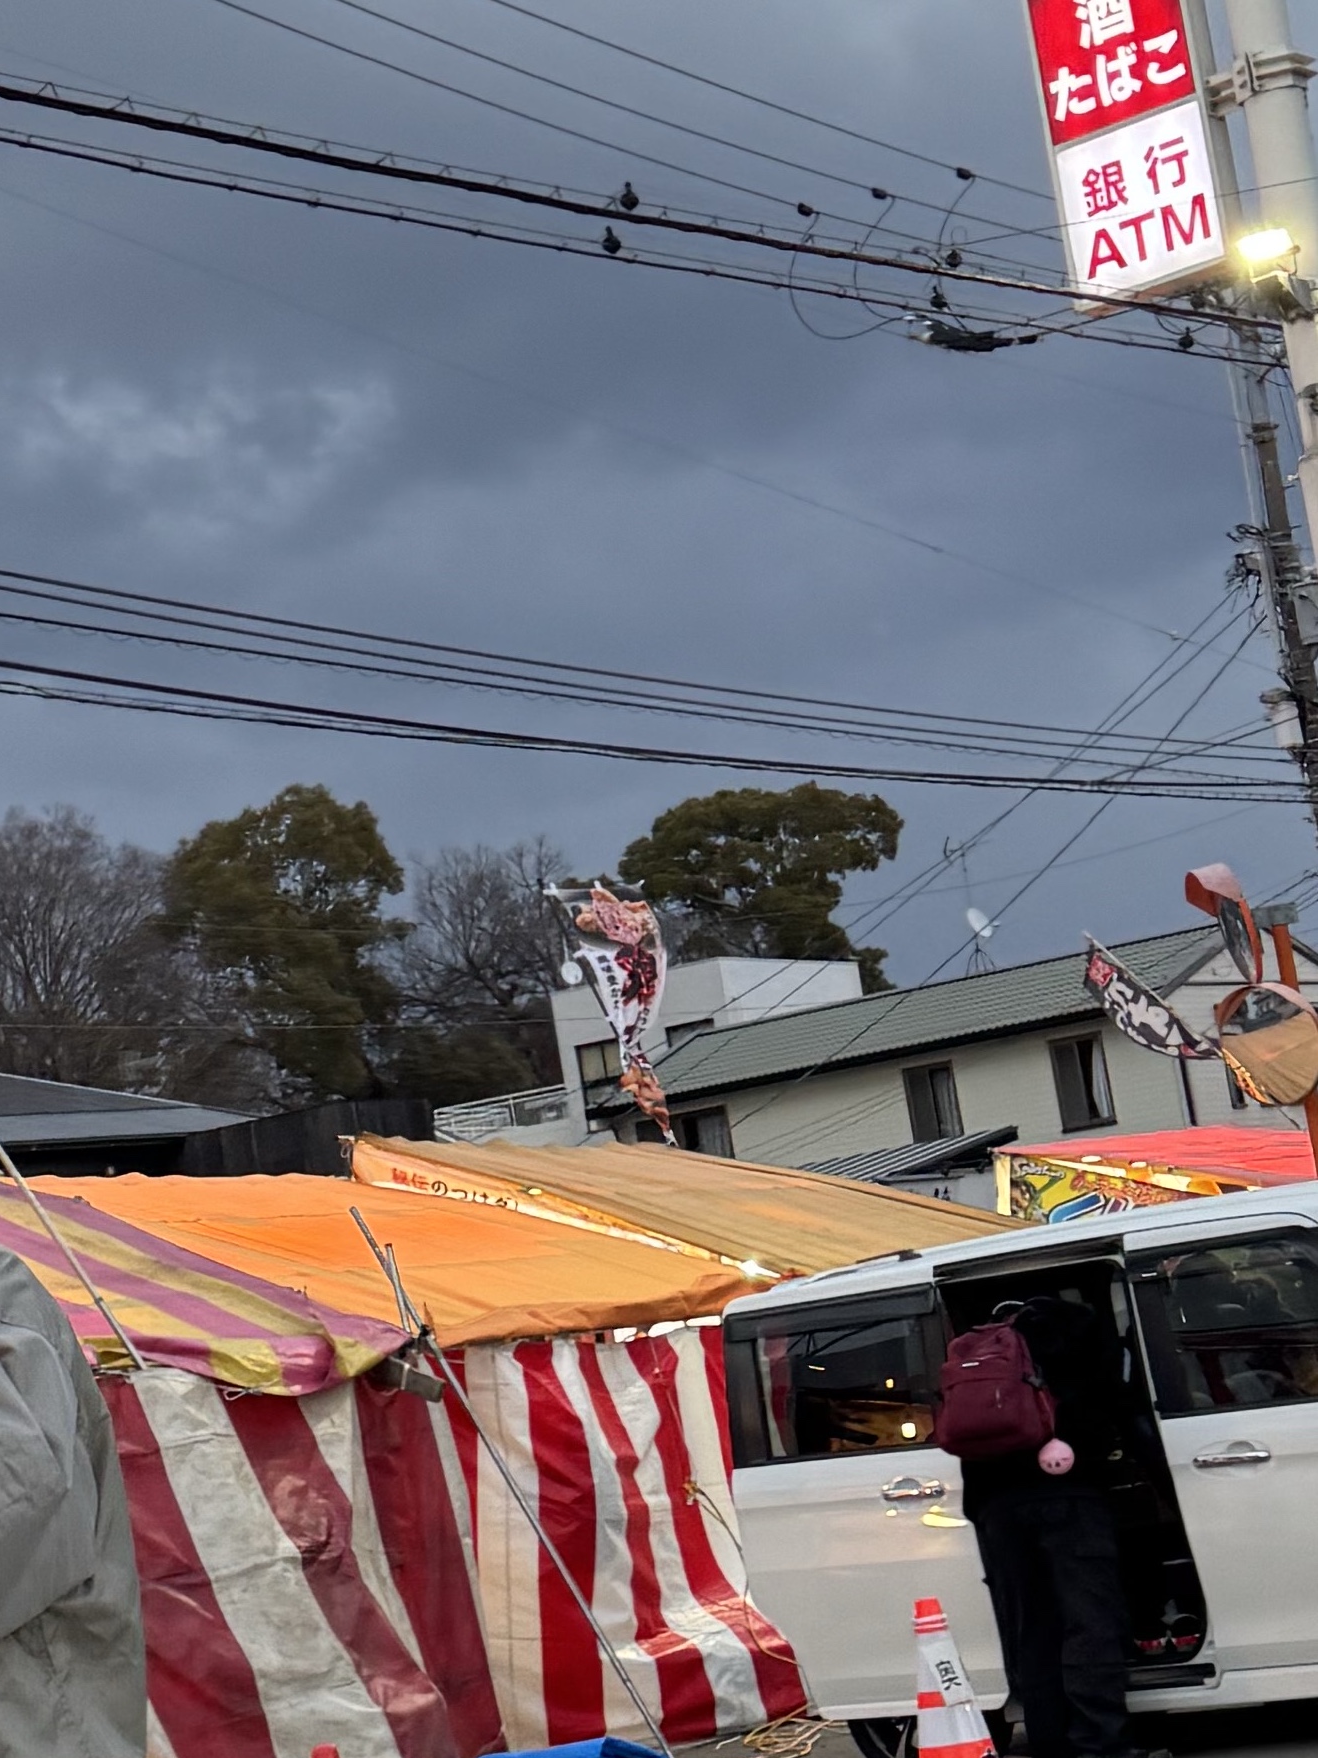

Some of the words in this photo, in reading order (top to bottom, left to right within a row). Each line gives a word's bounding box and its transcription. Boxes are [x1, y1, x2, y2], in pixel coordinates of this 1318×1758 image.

[1074, 0, 1135, 49] 酒
[1049, 29, 1186, 122] たばこ
[1082, 136, 1190, 218] 銀行
[1088, 193, 1211, 280] ATM
